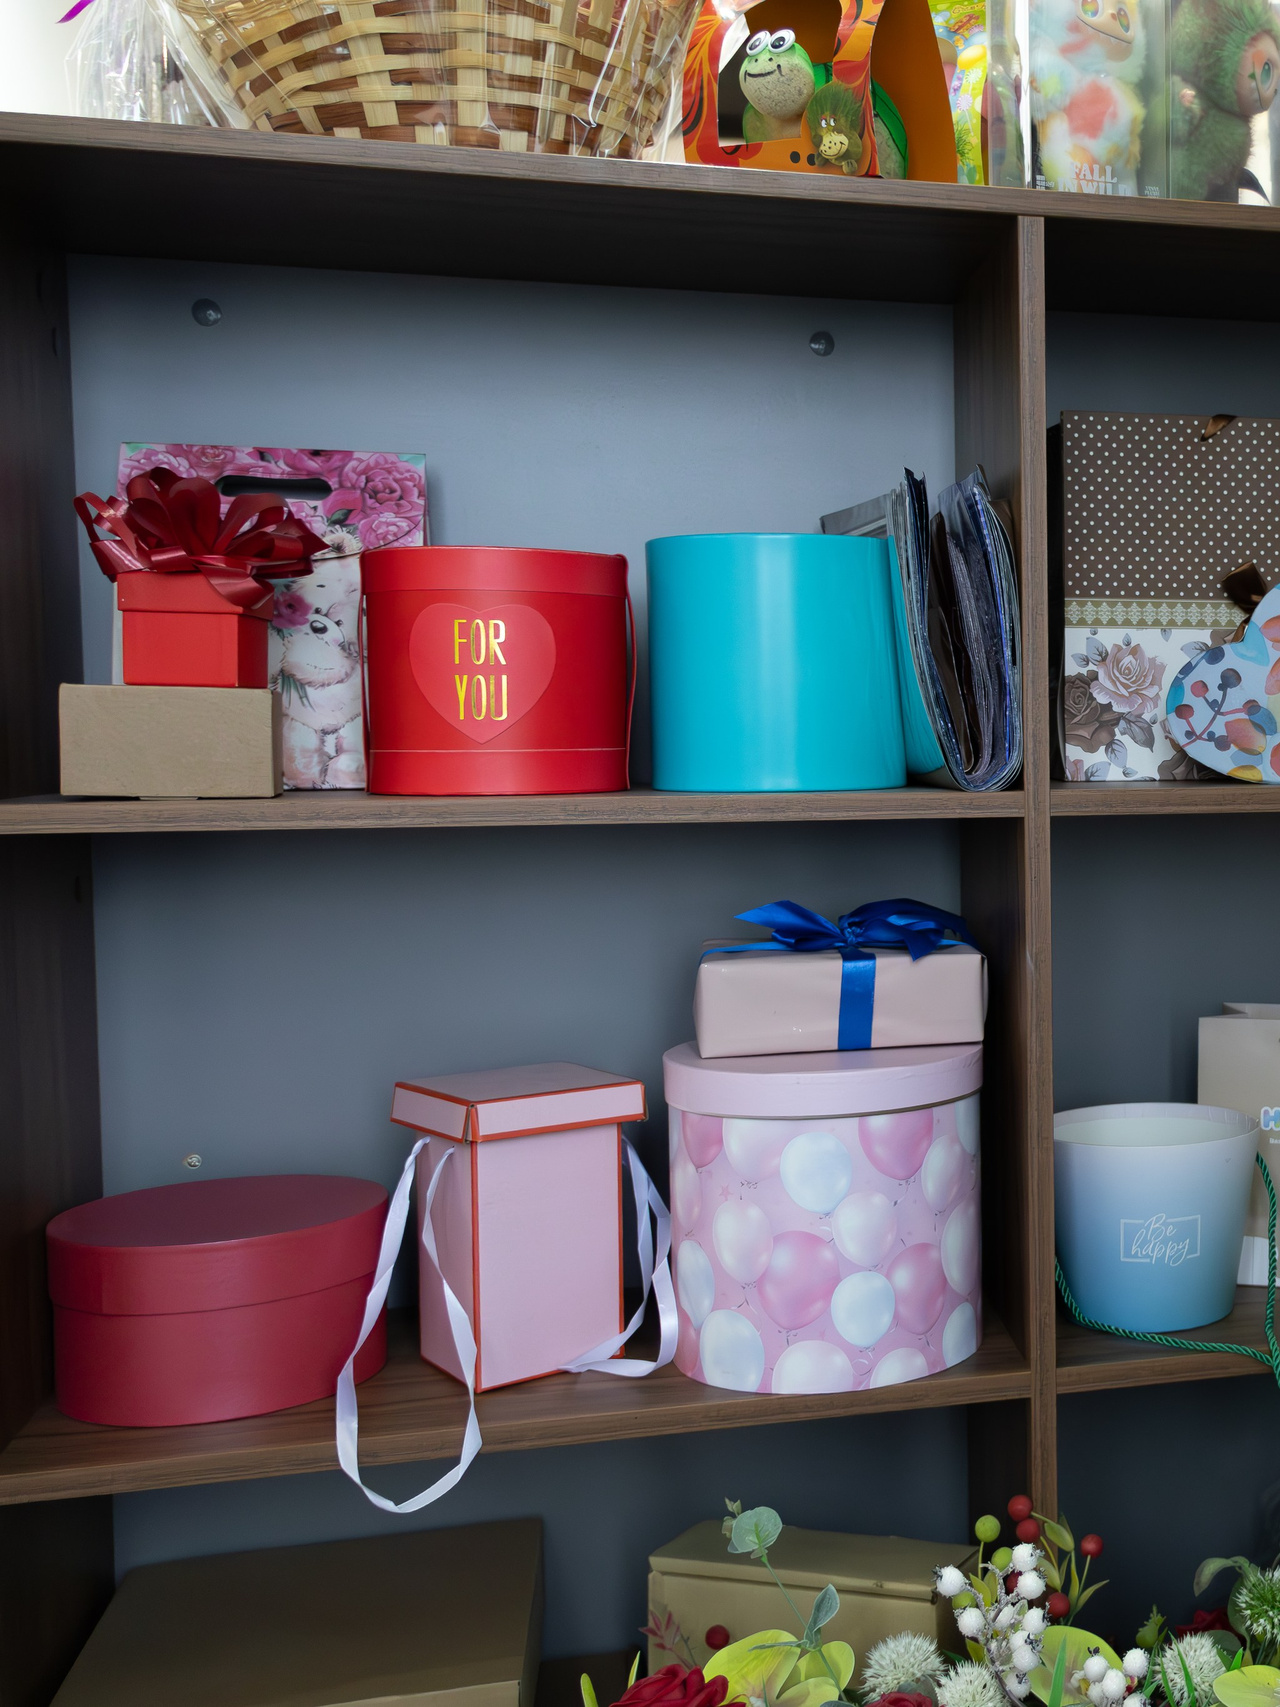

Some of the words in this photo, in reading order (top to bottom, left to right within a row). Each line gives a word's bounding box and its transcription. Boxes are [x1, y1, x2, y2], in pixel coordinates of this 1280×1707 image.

[1057, 177, 1078, 192] IN
[1069, 162, 1118, 183] FALL
[453, 618, 507, 665] FOR
[453, 674, 508, 721] YOU
[1144, 1213, 1177, 1242] Be
[1131, 1228, 1189, 1267] happy
